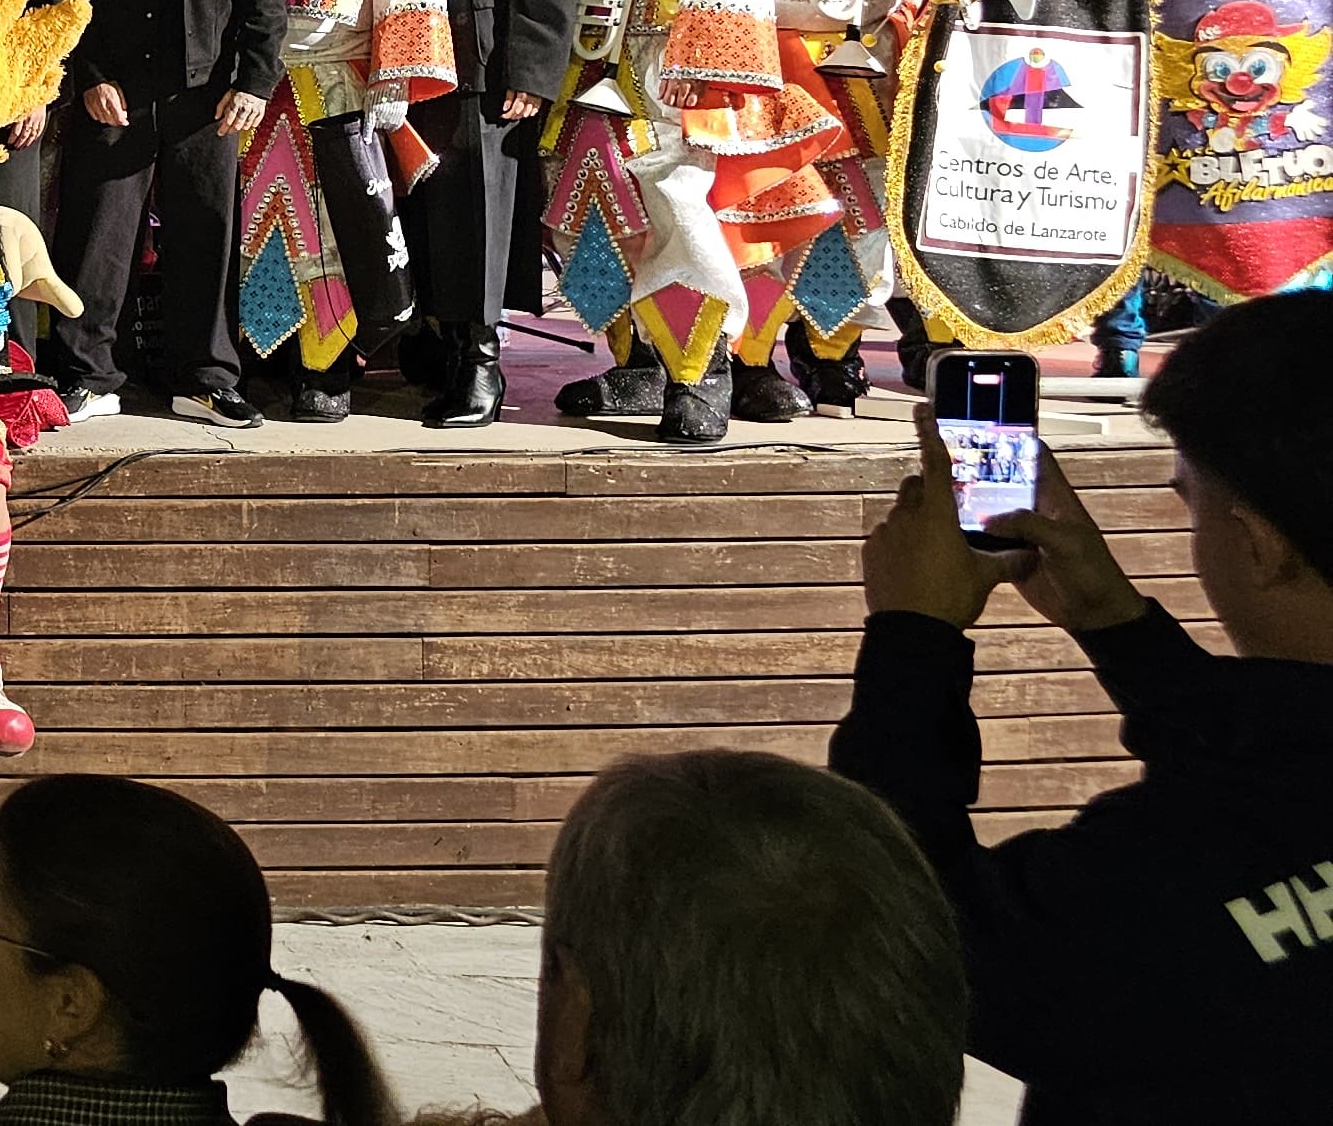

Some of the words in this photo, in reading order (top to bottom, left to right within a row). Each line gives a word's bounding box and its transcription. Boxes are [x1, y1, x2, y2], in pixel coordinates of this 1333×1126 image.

[938, 150, 1024, 178] Centros
[1034, 160, 1059, 181] de
[935, 176, 1014, 204] Cultura
[1016, 190, 1032, 211] y
[1035, 186, 1118, 211] Turismo
[939, 213, 998, 234] Cabildo
[1003, 221, 1025, 236] de
[1030, 222, 1107, 241] Lanzarote
